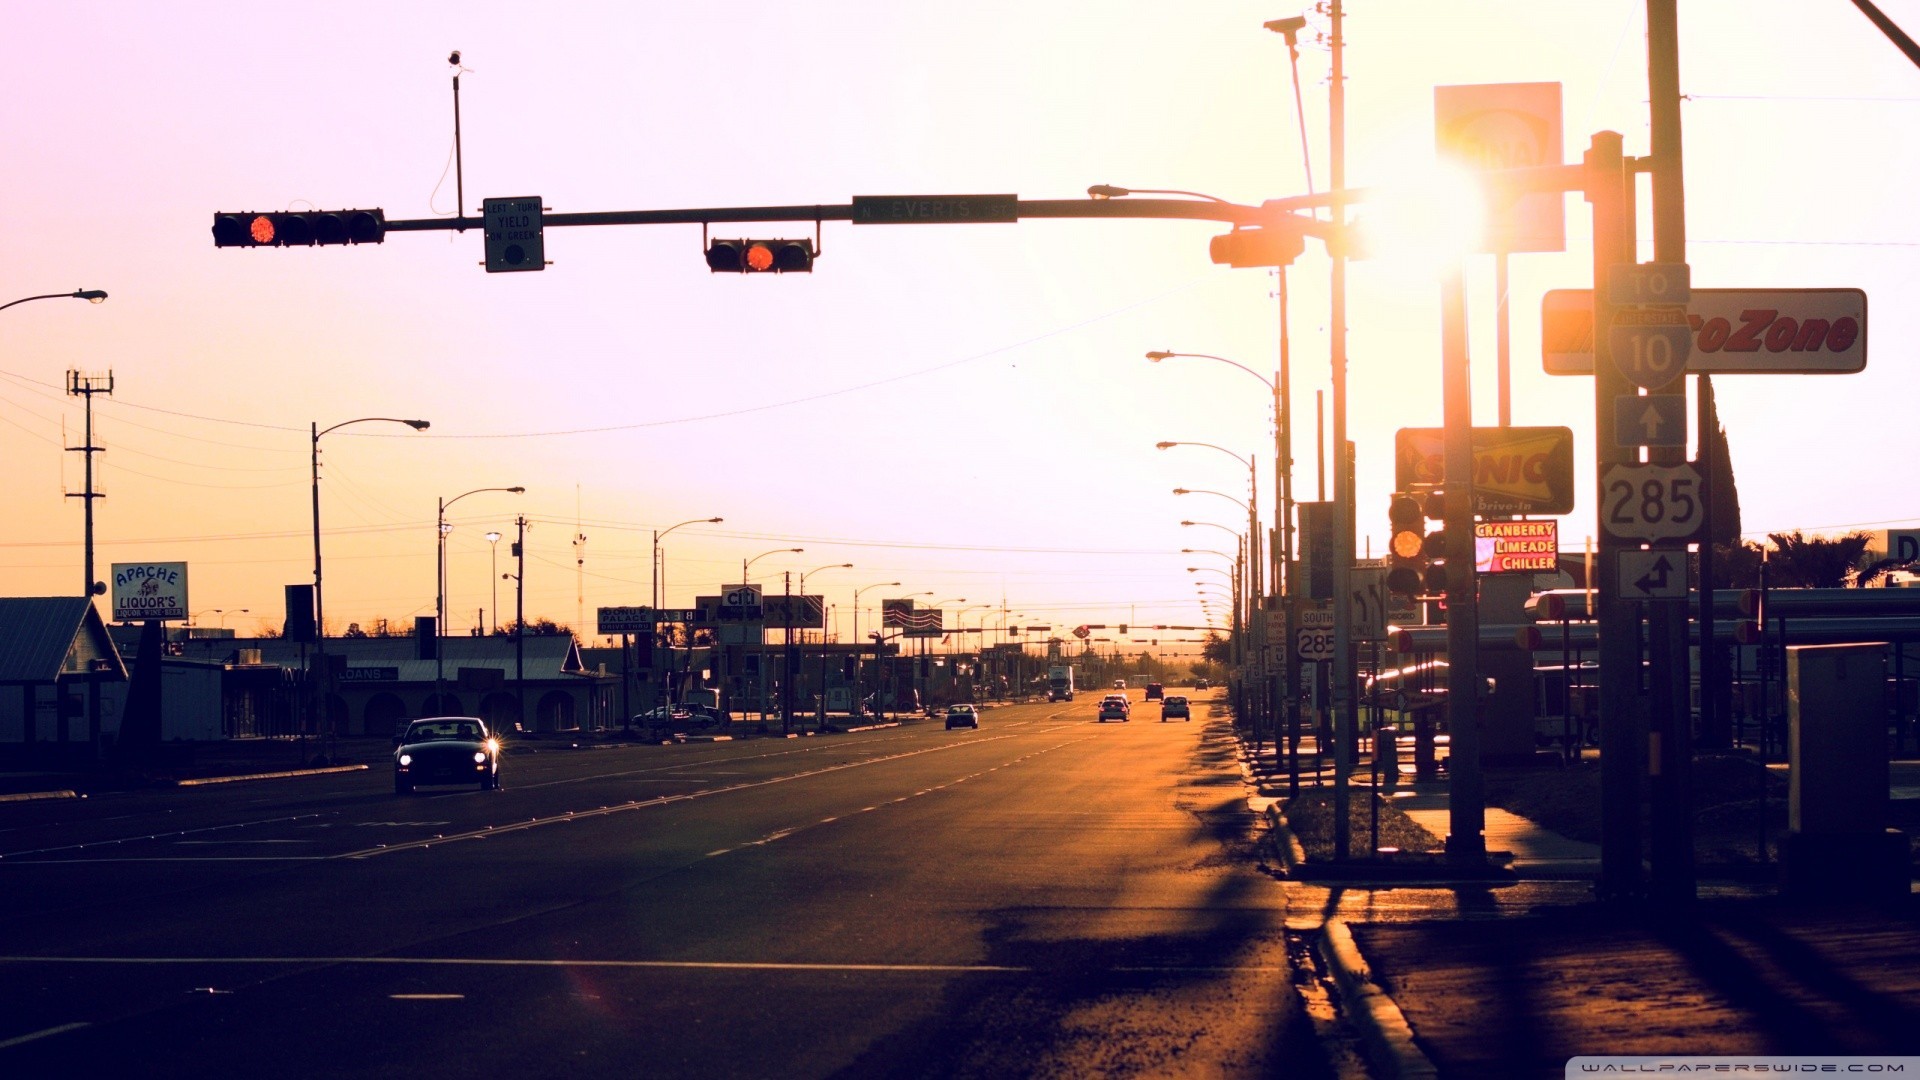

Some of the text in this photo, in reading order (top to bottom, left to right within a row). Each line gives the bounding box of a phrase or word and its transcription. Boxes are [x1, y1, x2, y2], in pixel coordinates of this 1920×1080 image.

[487, 203, 539, 213] LEFT TURN
[892, 201, 970, 218] EVERTS
[498, 216, 529, 228] YIELD
[490, 231, 535, 241] ON GREEN
[1632, 272, 1668, 295] TO
[1621, 312, 1679, 324] INTERSTATE
[1631, 334, 1672, 373] 10
[1416, 452, 1549, 484] SNIC
[1609, 479, 1695, 524] 285
[1475, 523, 1554, 537] CRANBERRY
[1496, 541, 1555, 553] LIMEADE
[1502, 557, 1555, 570] CHILLER
[116, 566, 178, 586] APACHE
[119, 596, 176, 608] LIQUOR'S
[1303, 612, 1333, 623] SOUTH
[1352, 624, 1371, 636] ONLY
[1300, 634, 1334, 653] 285
[1276, 653, 1283, 661] U
[338, 668, 381, 680] LOANS
